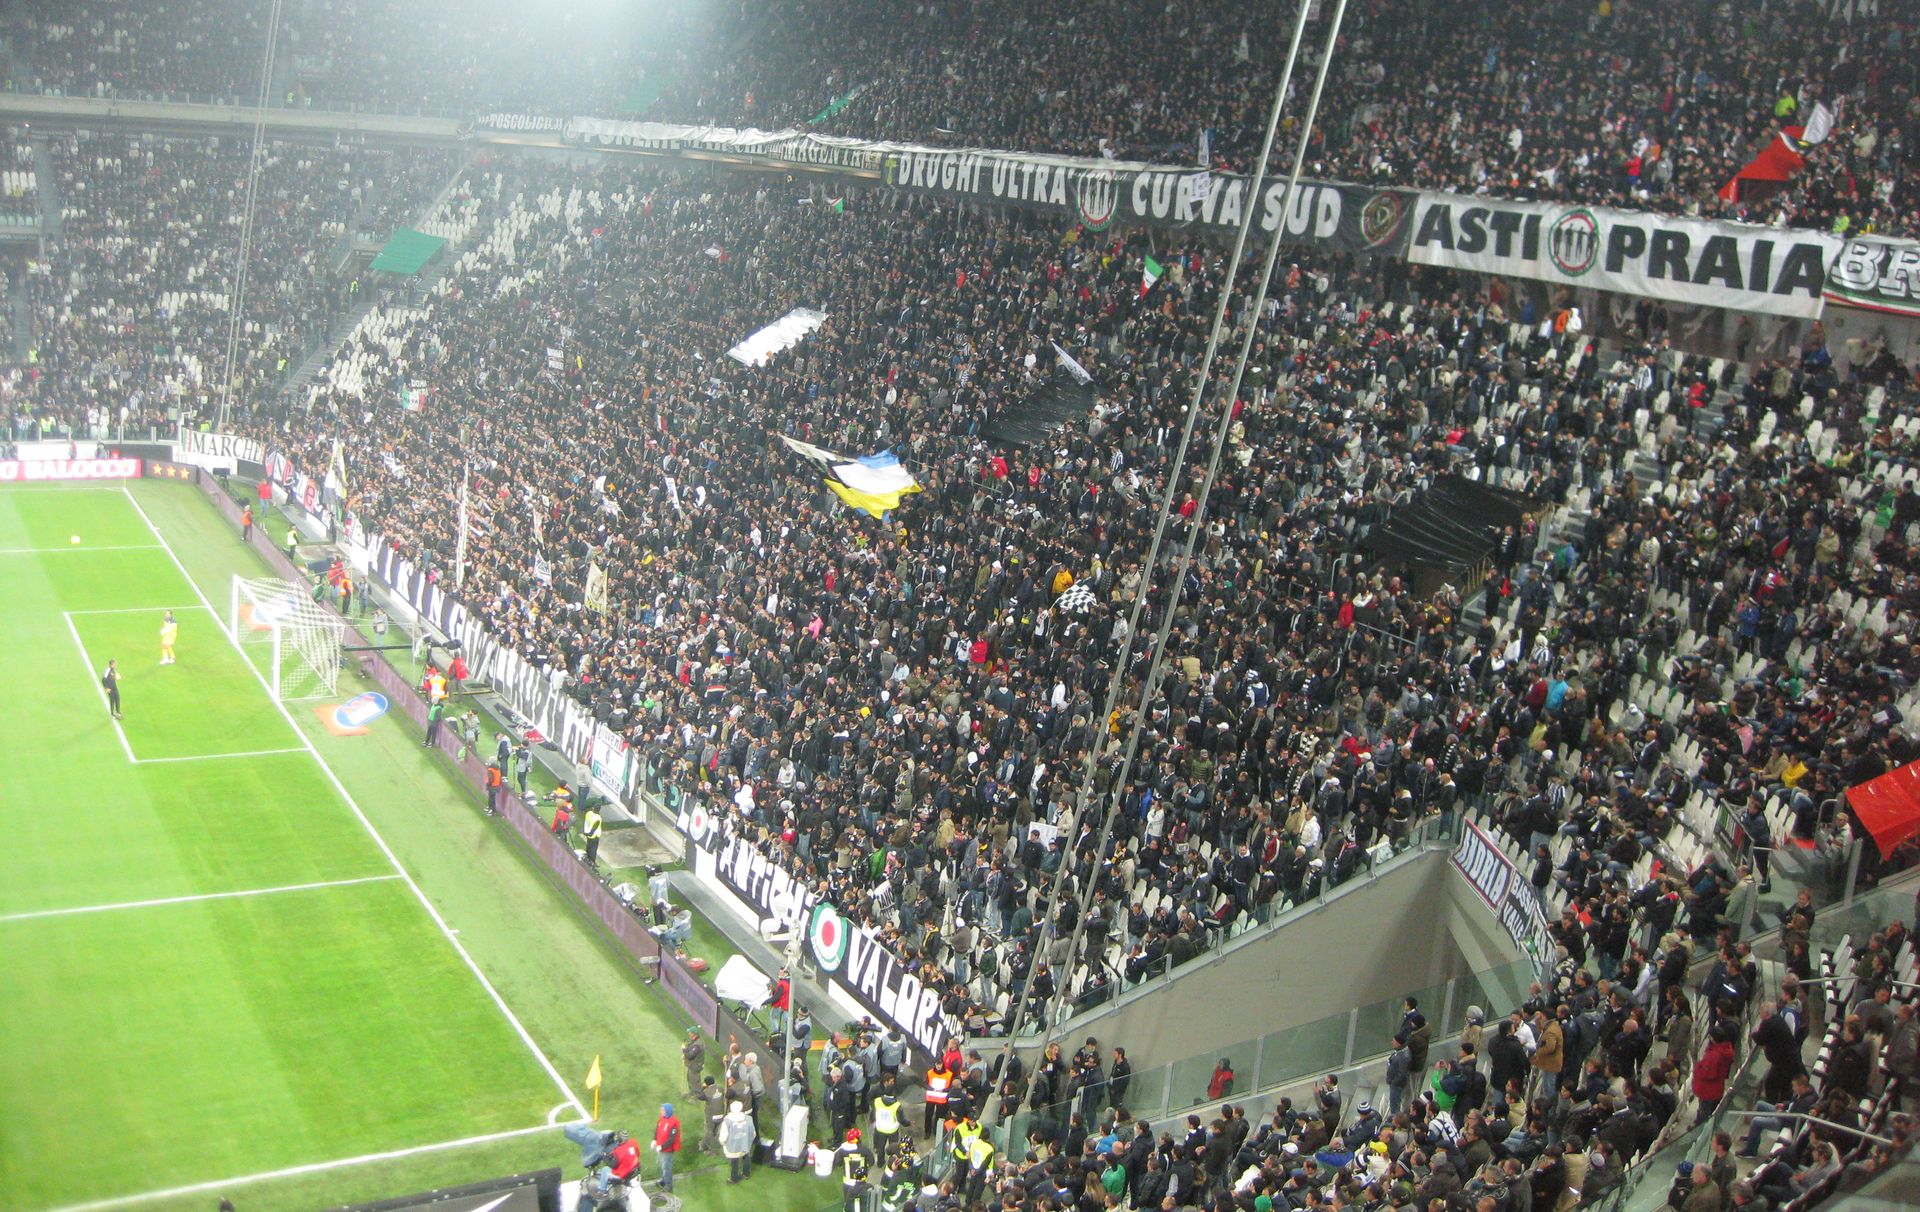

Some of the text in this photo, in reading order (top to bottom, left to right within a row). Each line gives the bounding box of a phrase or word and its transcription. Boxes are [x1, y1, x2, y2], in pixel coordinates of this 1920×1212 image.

[898, 151, 984, 194] DRUGHI
[1131, 170, 1241, 228] CURVA
[1260, 180, 1342, 240] SUD
[1413, 203, 1826, 299] ASTI PRAIA
[24, 458, 137, 480] BALOCCO
[1453, 825, 1508, 906] ANDRIA
[847, 925, 945, 1059] VALORI
